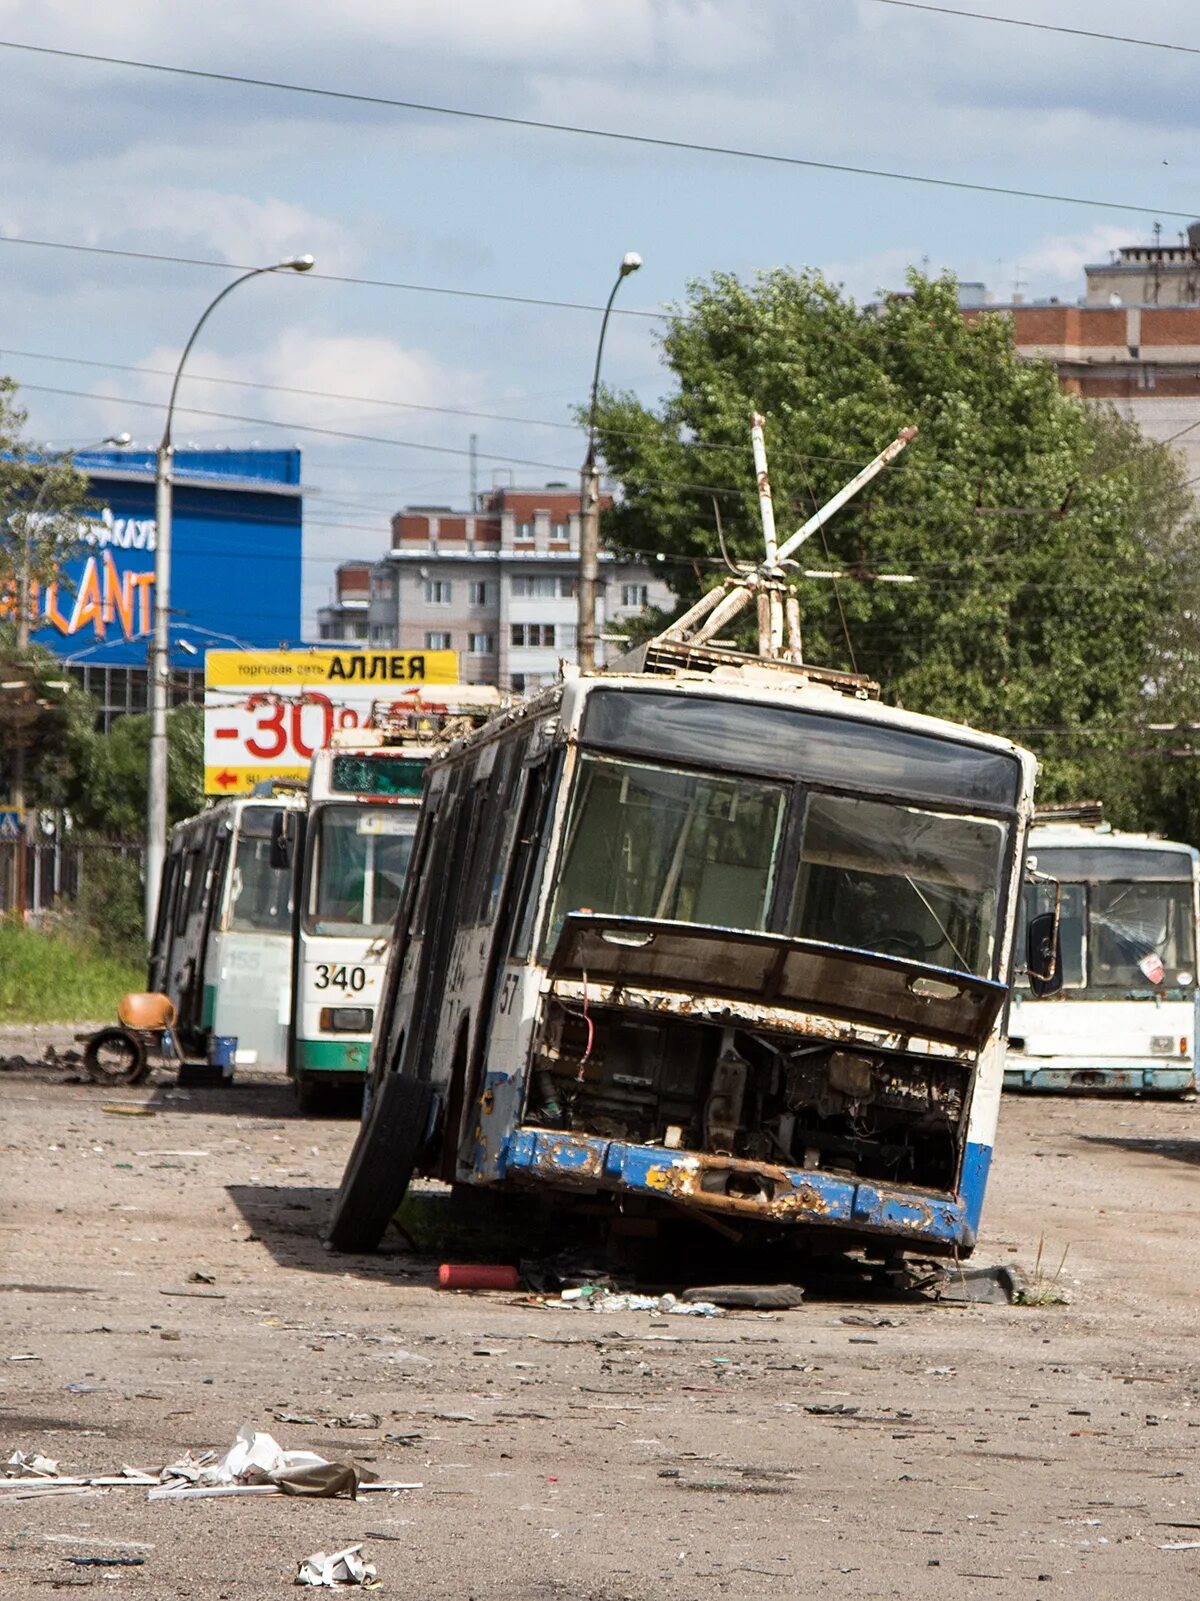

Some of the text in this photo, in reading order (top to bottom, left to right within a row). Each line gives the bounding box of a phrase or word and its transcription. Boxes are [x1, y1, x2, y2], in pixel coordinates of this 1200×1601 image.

[296, 664, 324, 674] сеть
[327, 656, 426, 680] АЛЛЕЯ
[214, 692, 373, 759] -30
[313, 964, 366, 992] 340
